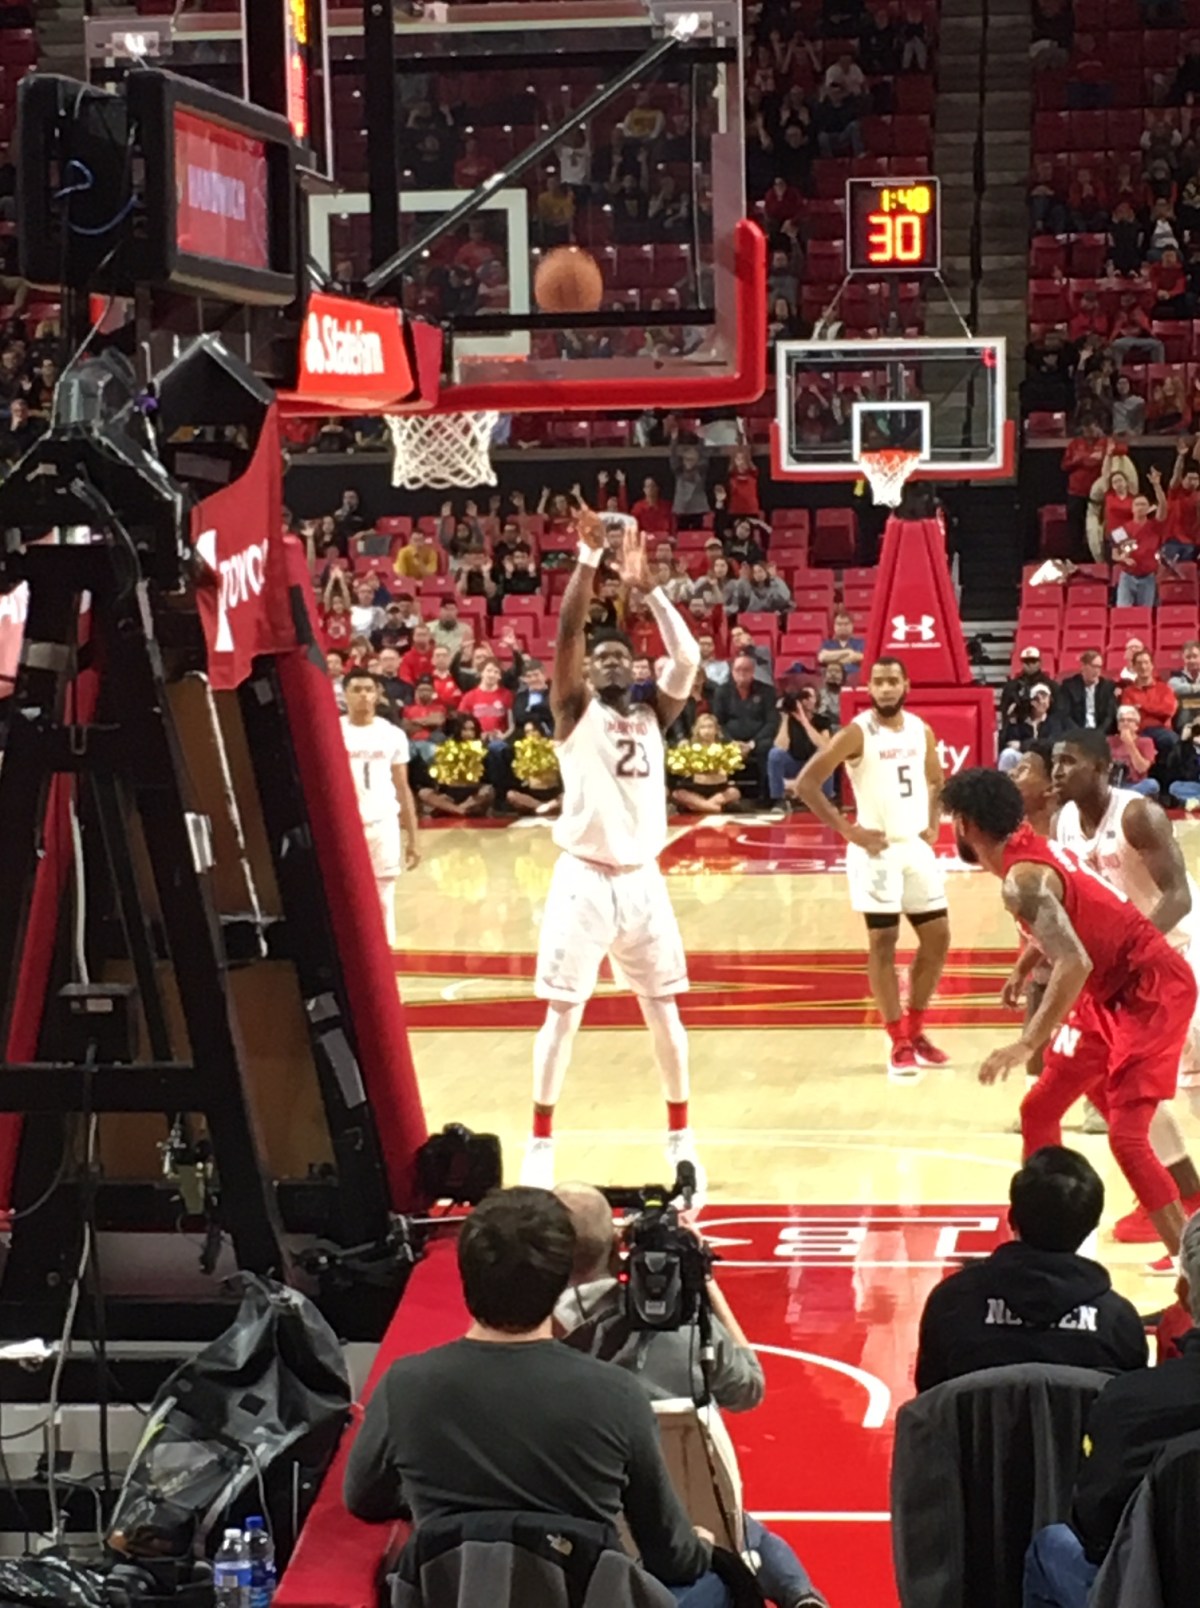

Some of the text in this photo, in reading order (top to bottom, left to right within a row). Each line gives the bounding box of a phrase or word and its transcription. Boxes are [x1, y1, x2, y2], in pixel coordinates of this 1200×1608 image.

[869, 215, 920, 261] 30
[218, 537, 269, 609] TOYO
[363, 761, 370, 791] 1
[615, 738, 650, 778] 23
[897, 765, 912, 798] 5
[1052, 1024, 1082, 1058] N
